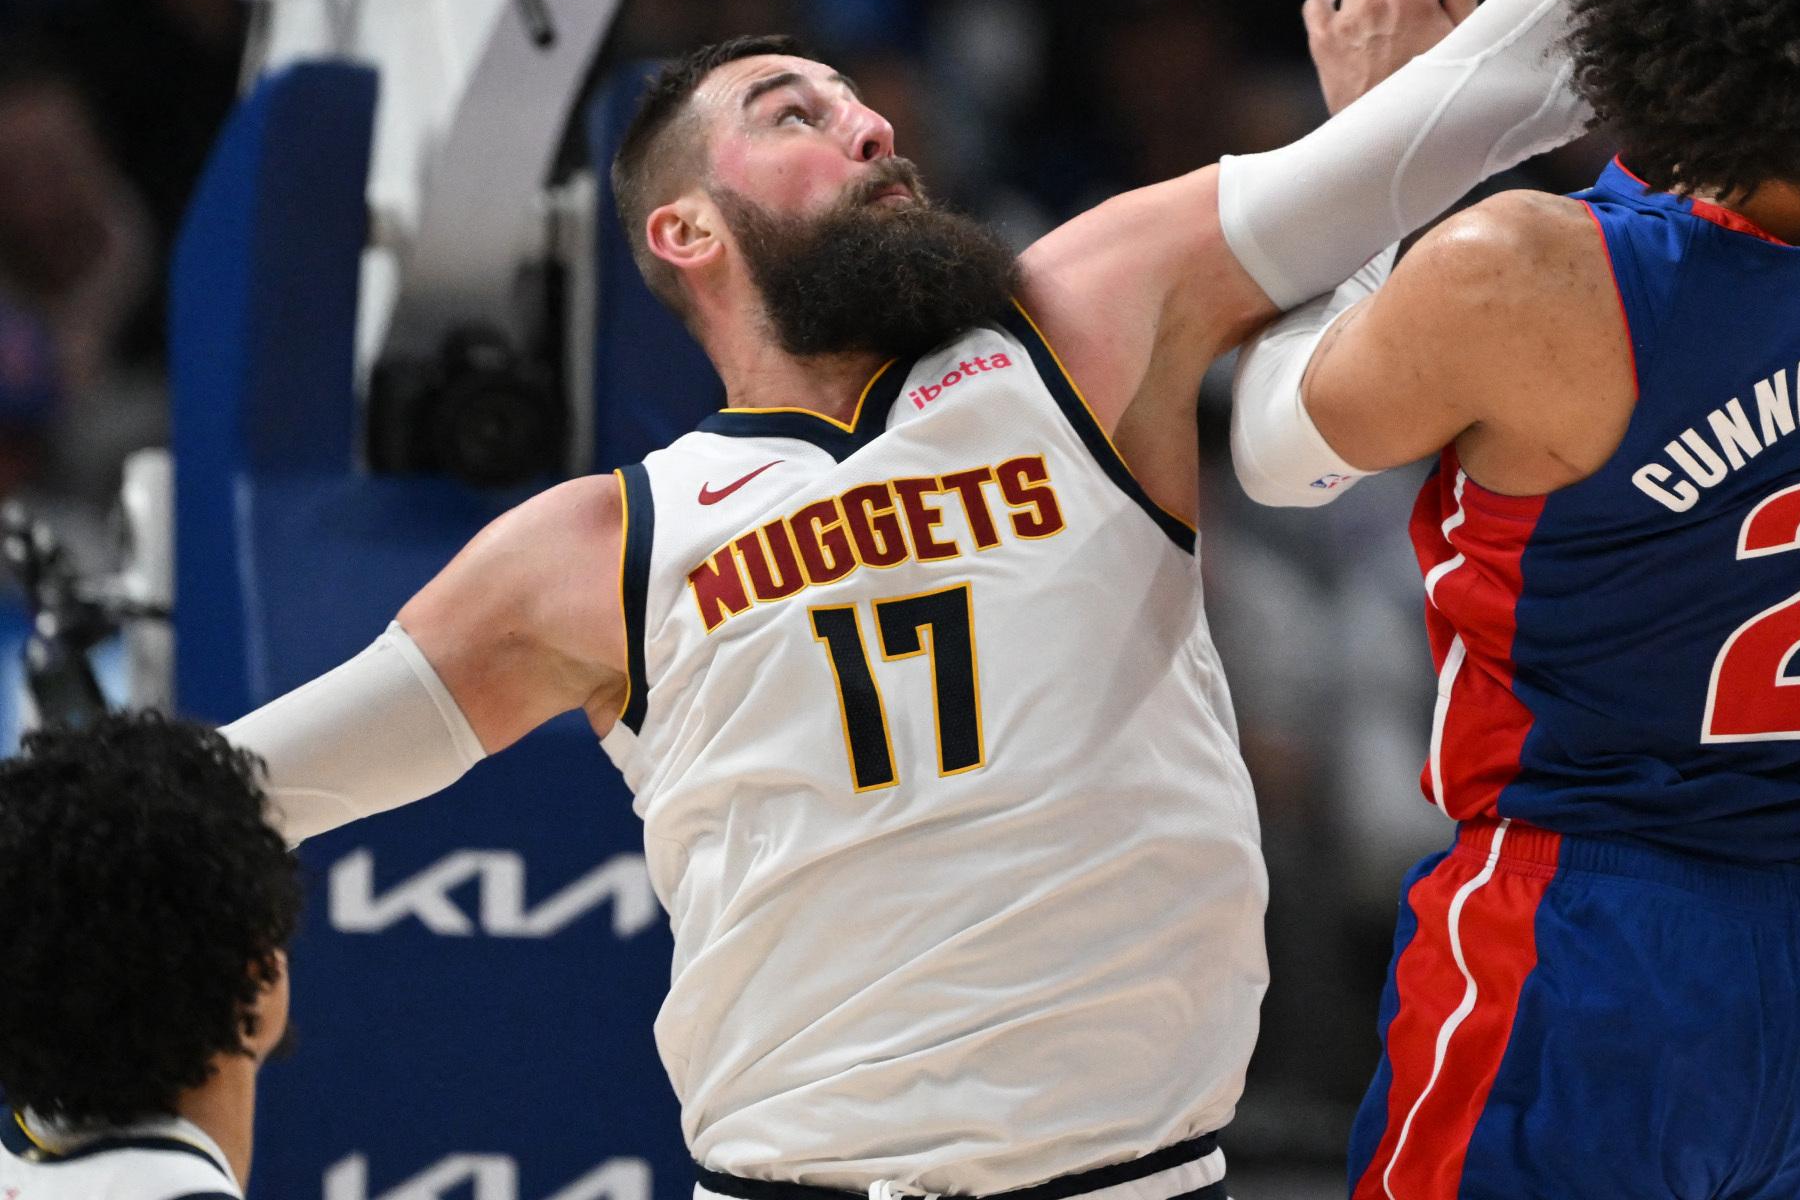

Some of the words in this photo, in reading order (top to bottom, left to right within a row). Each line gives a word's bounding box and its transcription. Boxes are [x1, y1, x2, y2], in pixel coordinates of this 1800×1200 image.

[908, 352, 1012, 411] ibotta
[686, 451, 1067, 634] NUGGETS
[807, 580, 986, 794] 17
[328, 848, 658, 939] KIA
